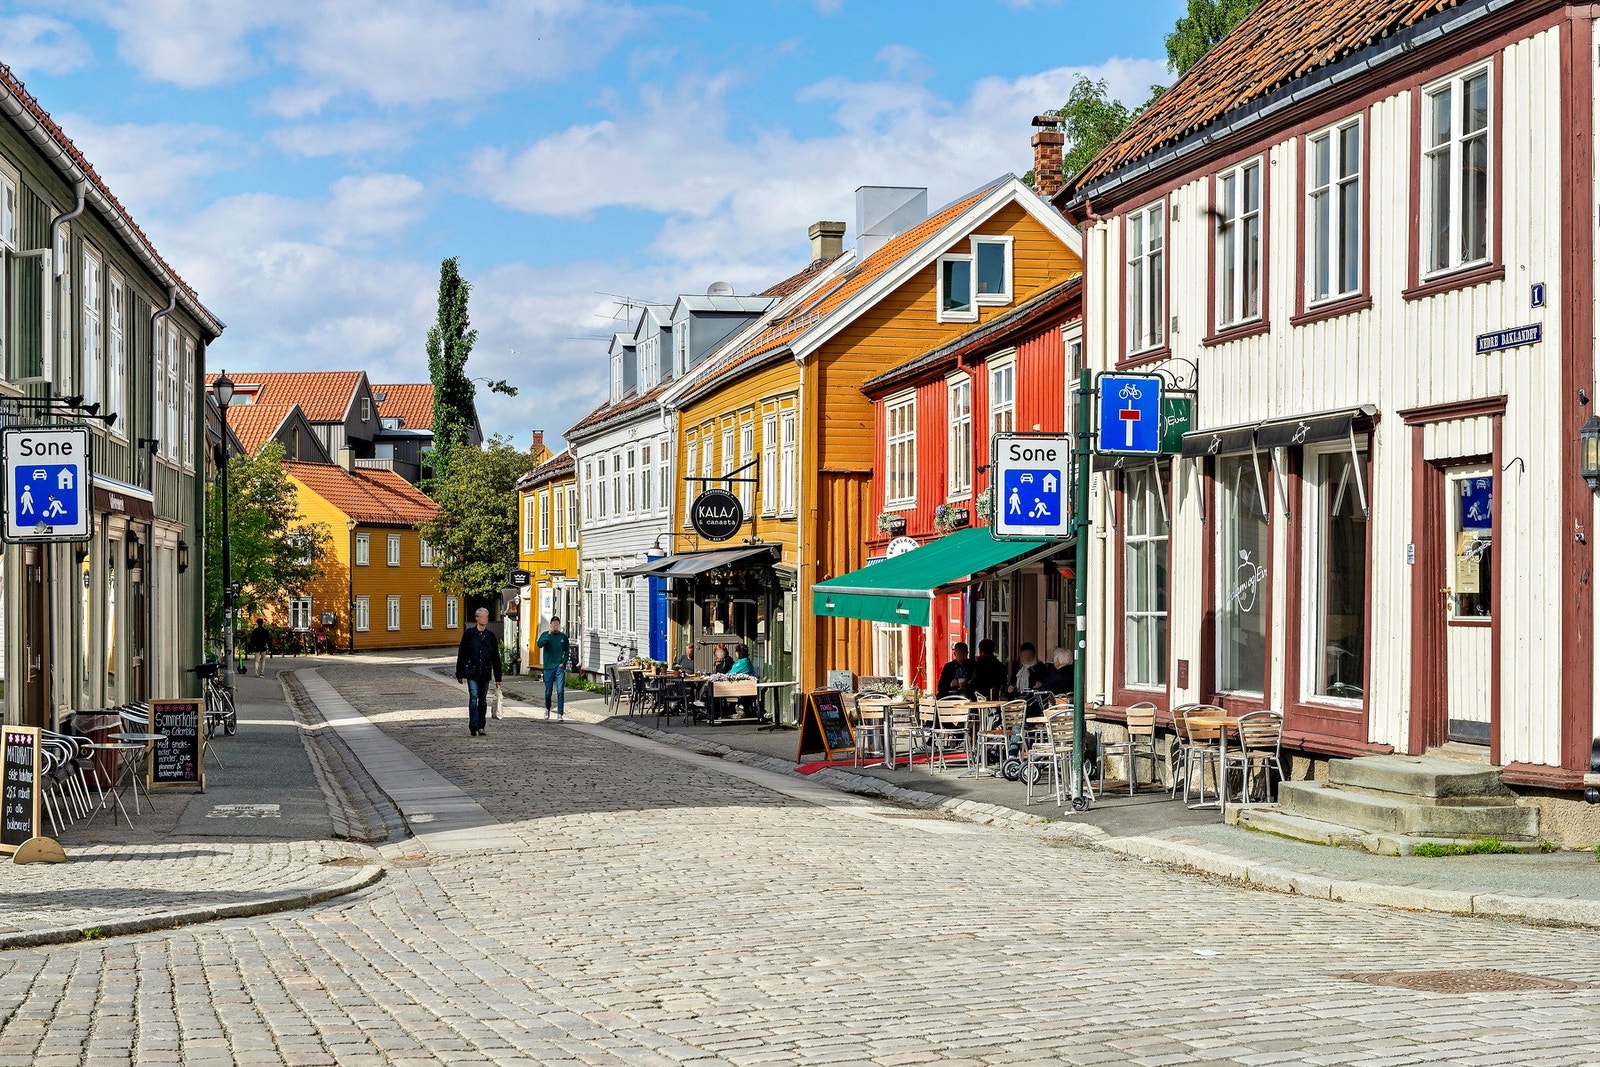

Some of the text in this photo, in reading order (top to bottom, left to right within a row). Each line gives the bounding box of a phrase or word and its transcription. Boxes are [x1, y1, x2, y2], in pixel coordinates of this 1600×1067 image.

[1534, 287, 1540, 304] 1
[1479, 328, 1538, 350] NEDRE BAKLANDET
[1168, 415, 1188, 426] Eva
[20, 438, 72, 456] Sone
[1009, 444, 1057, 461] Sone
[699, 506, 735, 518] KALAS
[171, 727, 196, 736] Colombia
